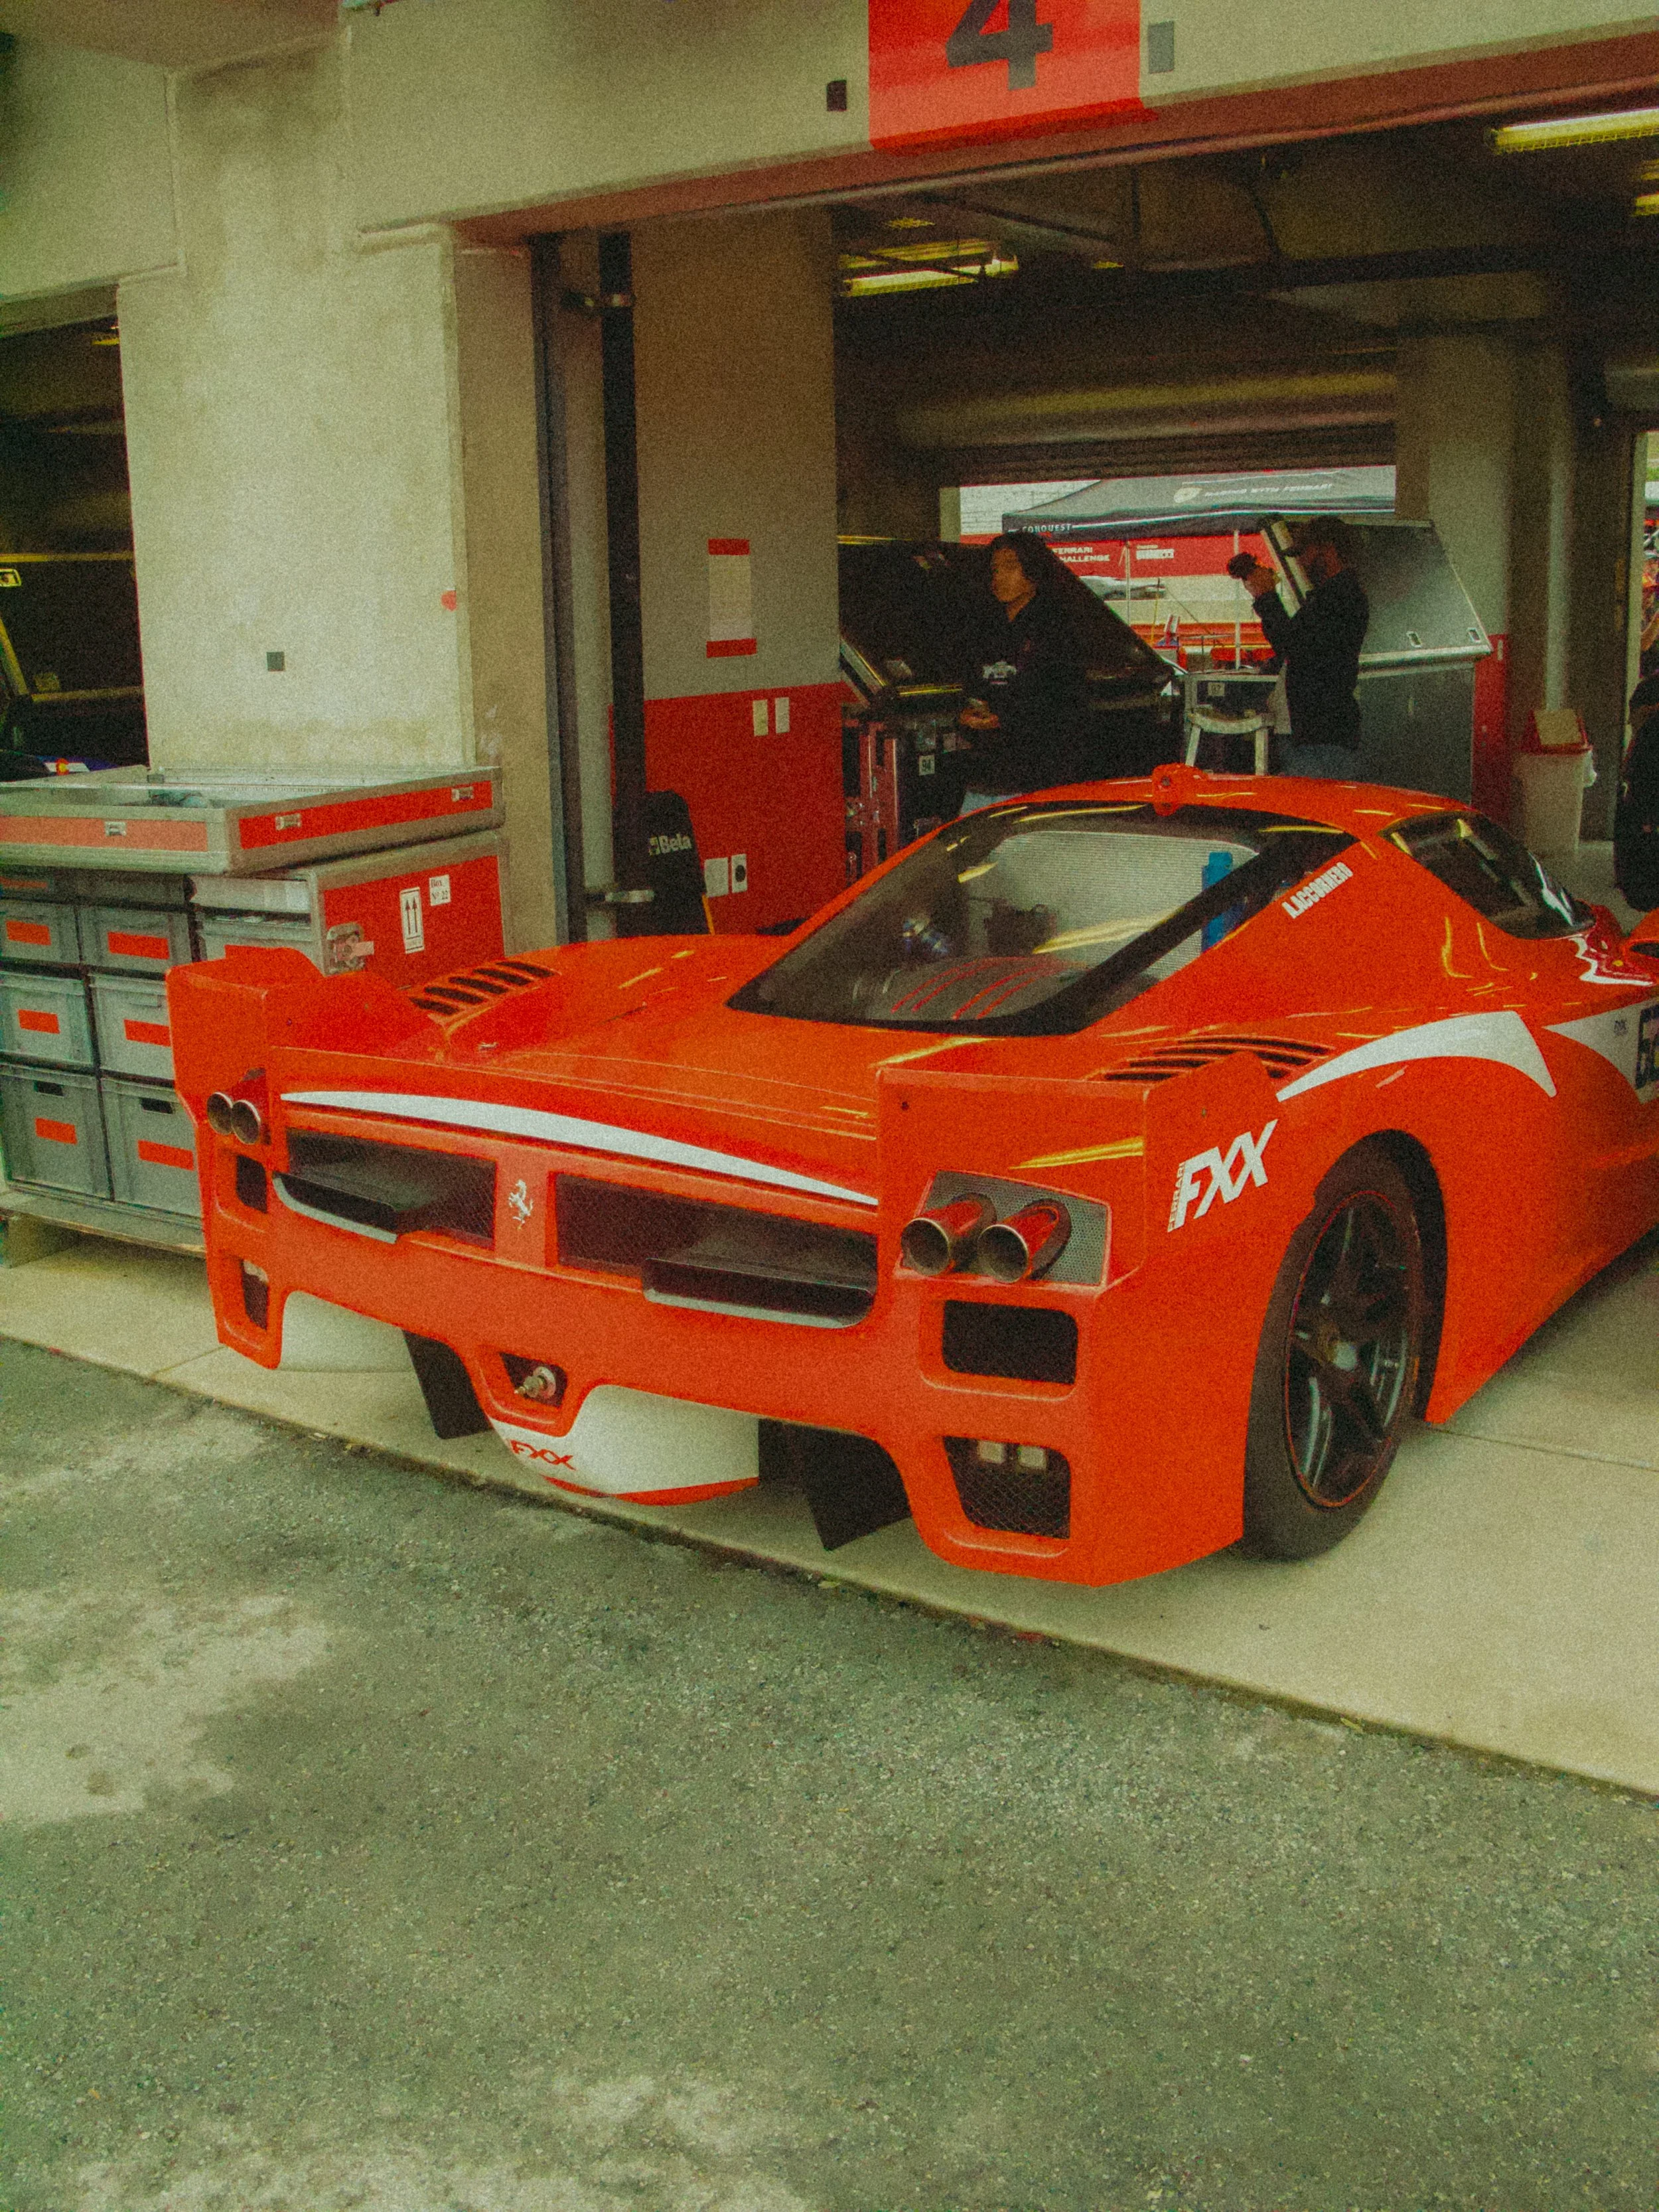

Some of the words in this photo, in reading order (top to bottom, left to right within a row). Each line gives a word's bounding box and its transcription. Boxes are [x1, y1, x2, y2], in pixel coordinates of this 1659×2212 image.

[946, 0, 1054, 90] 4
[1021, 523, 1072, 534] CONQUEST
[1052, 546, 1093, 555] FERRARI
[1059, 554, 1110, 563] HALLENGE
[659, 834, 691, 853] Beta
[1174, 1118, 1279, 1229] FXX
[510, 1439, 577, 1471] FXX
